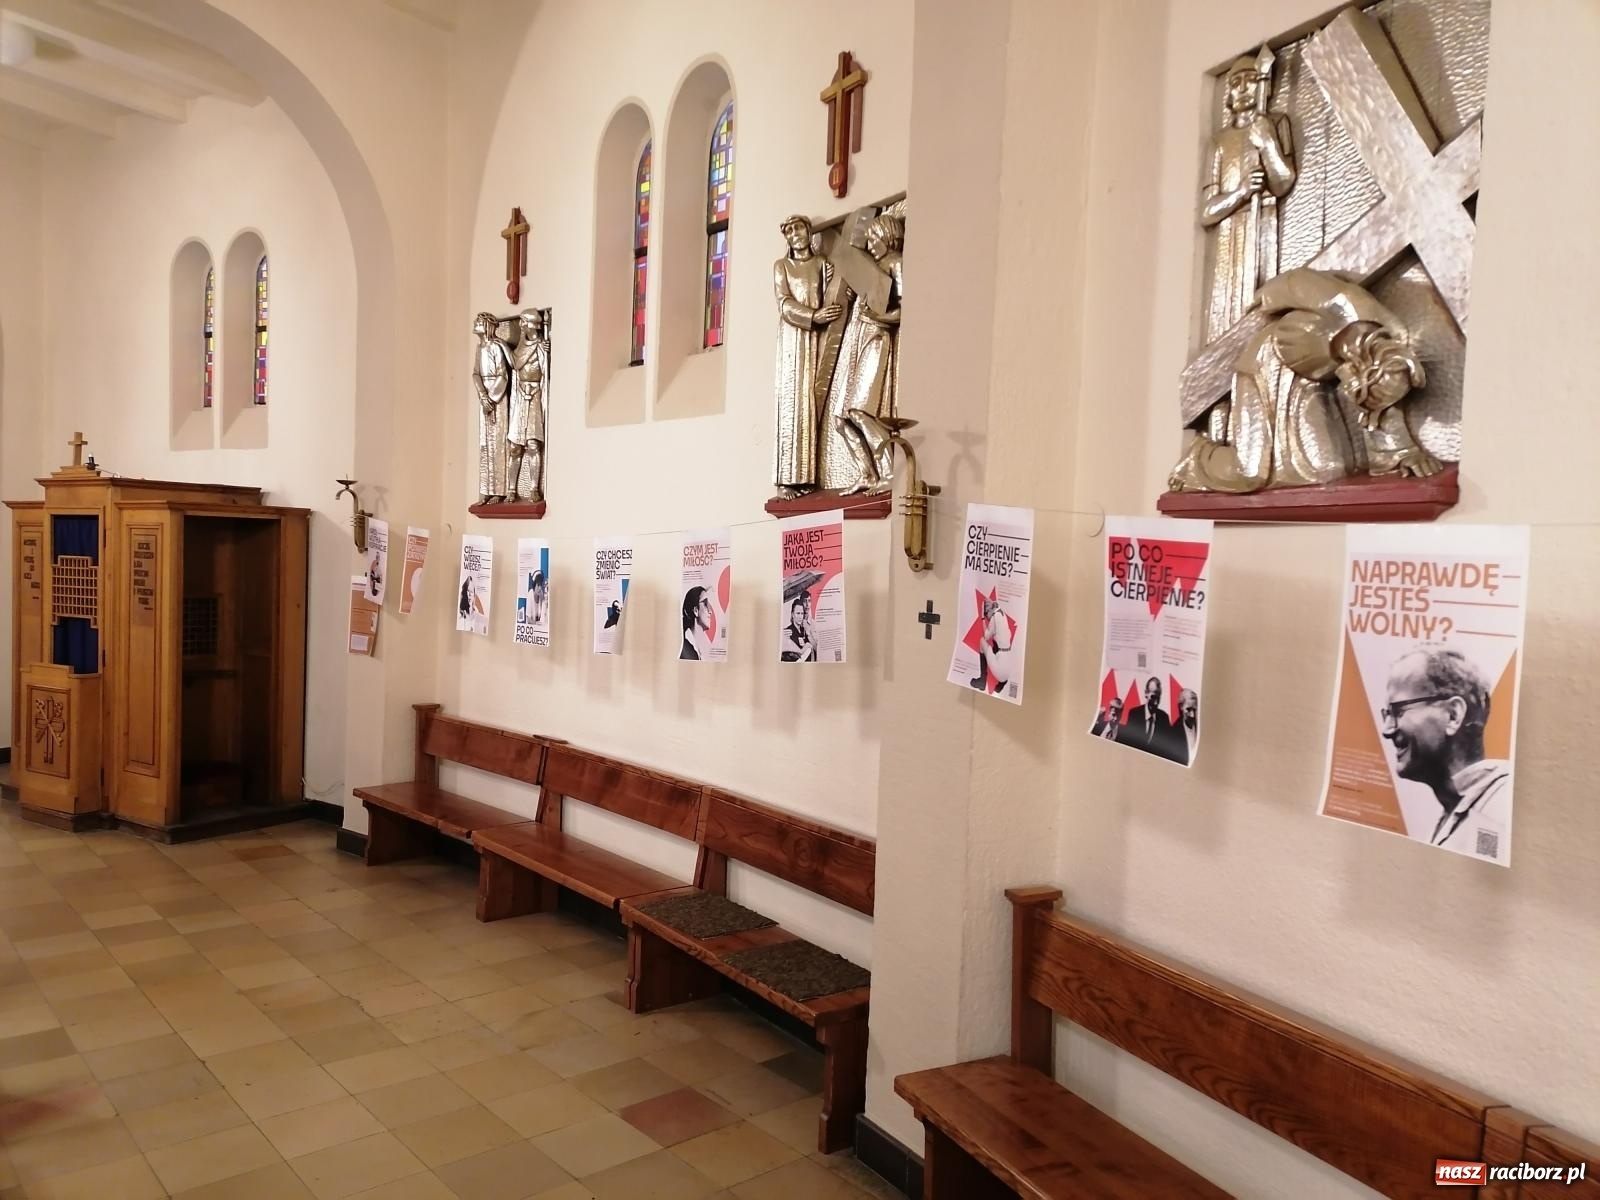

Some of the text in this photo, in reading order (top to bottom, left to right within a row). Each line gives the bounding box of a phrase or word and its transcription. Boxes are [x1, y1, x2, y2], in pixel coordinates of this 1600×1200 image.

[783, 529, 824, 546] JAKA JEST
[968, 524, 988, 541] CZY
[596, 550, 607, 560] CZY
[683, 542, 719, 557] CZYM JEST
[783, 543, 814, 558] TWOJA
[966, 540, 1020, 562] CIERPIENIE
[1111, 542, 1164, 563] PO CO
[964, 555, 1014, 578] MA SENS?
[1111, 560, 1173, 585] ISTNIEJE
[1351, 559, 1500, 597] NAPRAWDĘ
[1110, 580, 1206, 611] CIERPIENIE?
[1349, 584, 1431, 613] JESTEŚ
[516, 625, 534, 635] PO CO
[1348, 609, 1454, 642] WOLNY?
